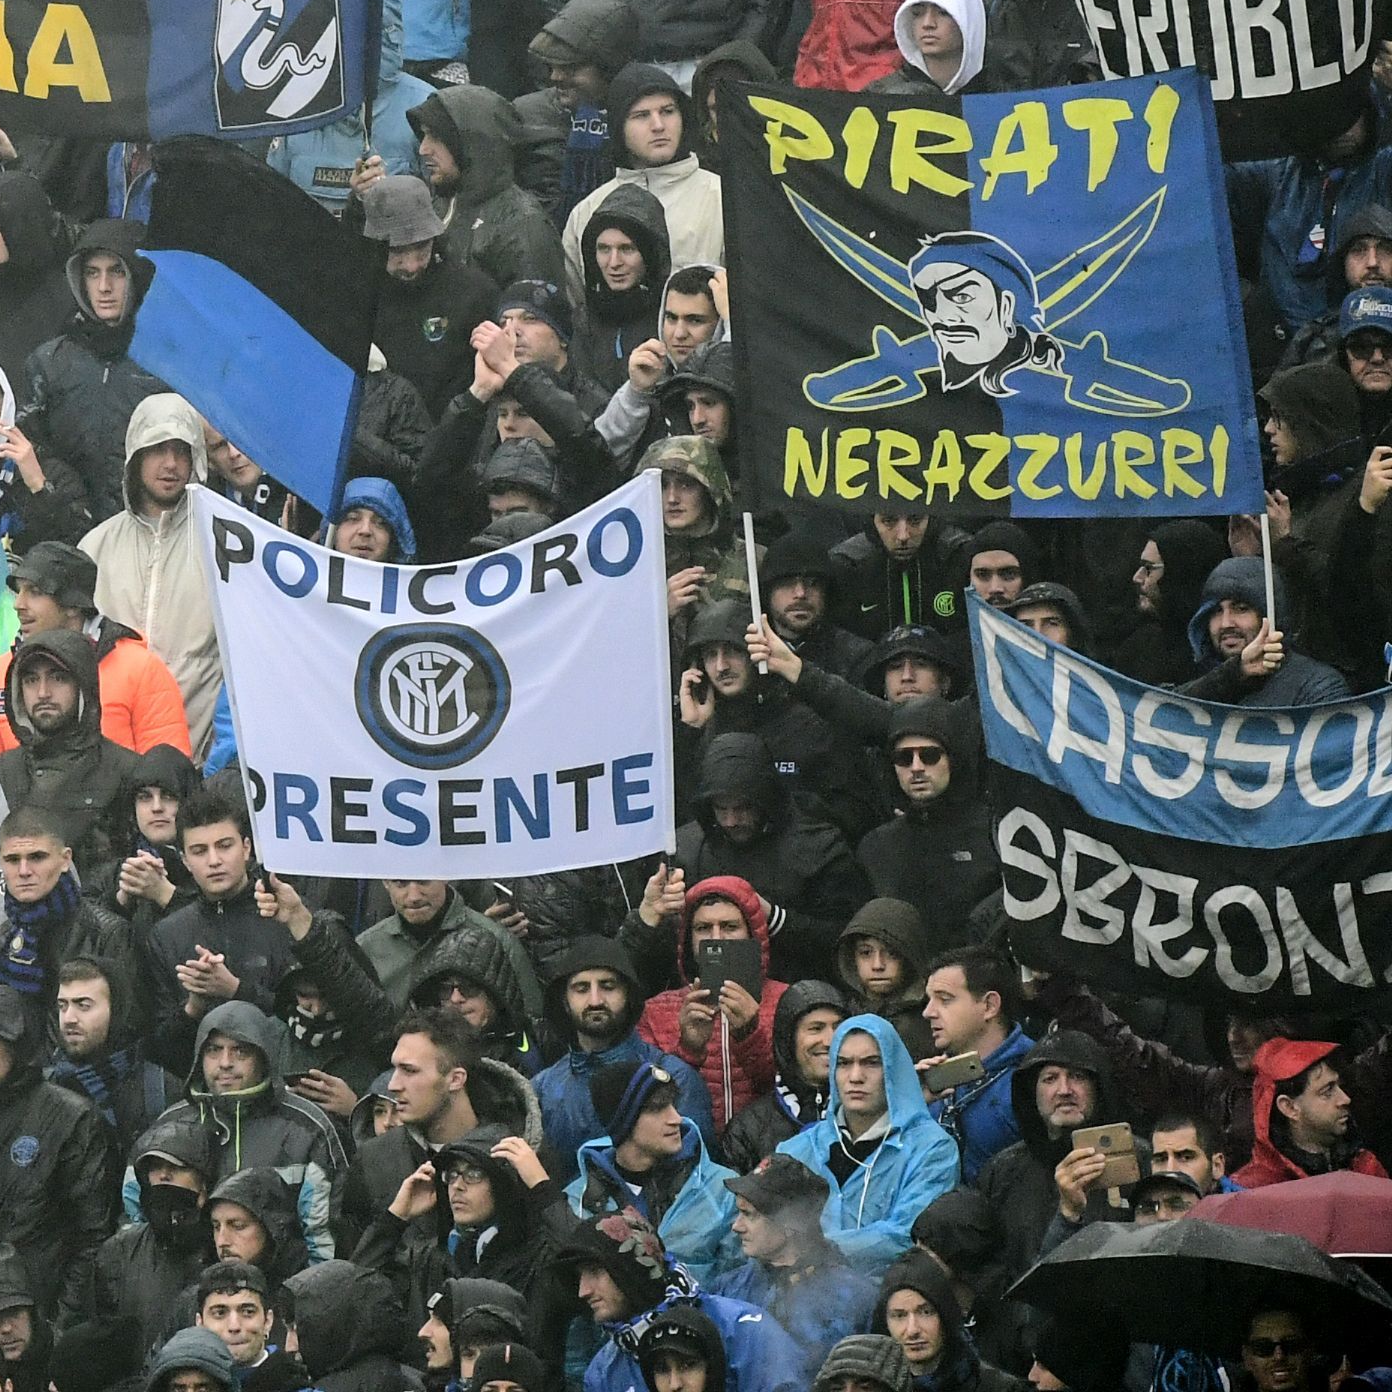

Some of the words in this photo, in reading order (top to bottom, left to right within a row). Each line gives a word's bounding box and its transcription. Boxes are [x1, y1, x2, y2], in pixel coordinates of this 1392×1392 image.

[747, 83, 1182, 200] PIRATI
[783, 424, 1229, 506] NERAZZURRI
[211, 506, 644, 615] POLICORO
